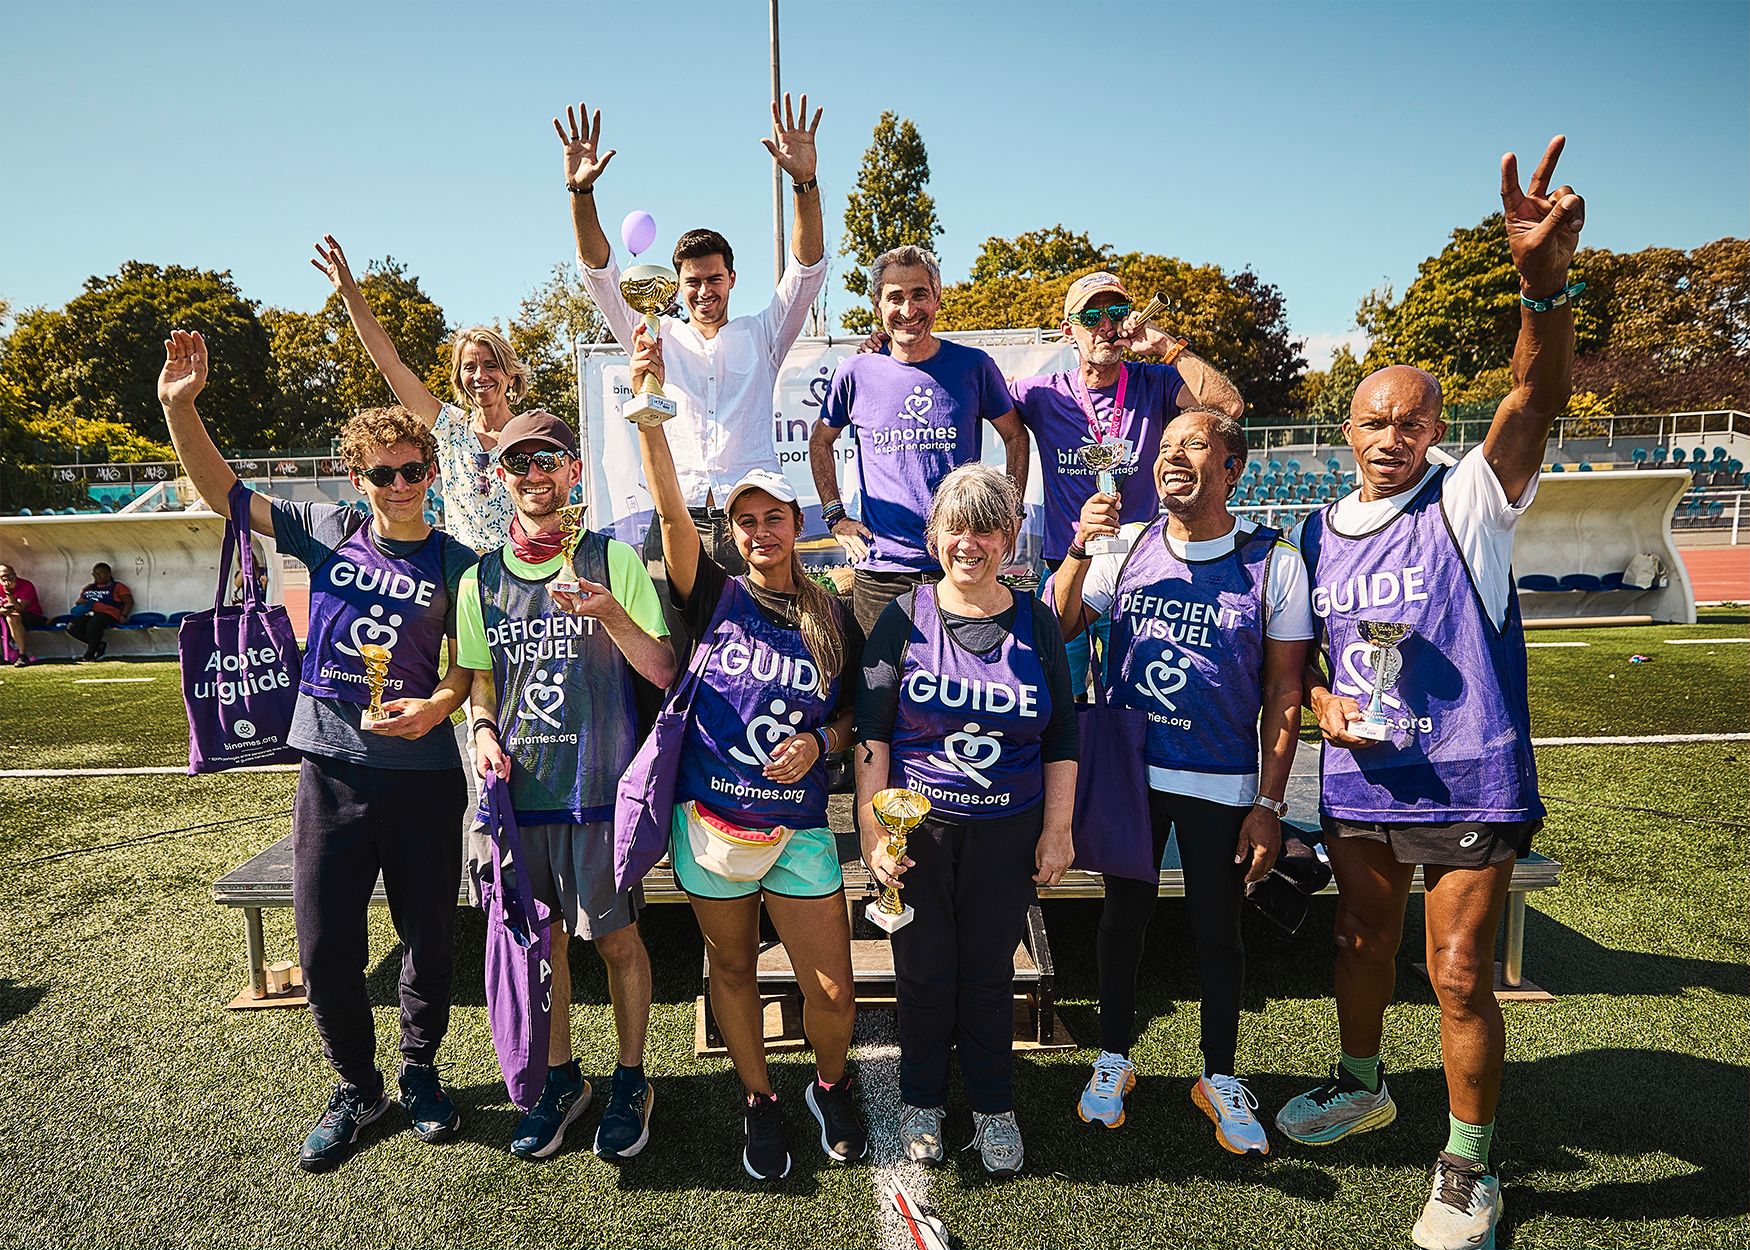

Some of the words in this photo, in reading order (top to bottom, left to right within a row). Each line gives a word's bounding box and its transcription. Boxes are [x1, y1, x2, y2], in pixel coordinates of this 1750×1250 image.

[871, 426, 957, 445] binomes
[919, 442, 957, 452] partage
[330, 561, 436, 608] GUIDE
[1311, 565, 1429, 618] GUIDE
[1120, 589, 1242, 631] DÉFICIENT
[486, 616, 597, 647] DÉFICIENT
[1130, 615, 1212, 648] VISUEL
[503, 638, 579, 665] VISUEL
[908, 669, 1038, 718] GUIDE
[223, 735, 278, 751] binomes.org
[710, 776, 806, 804] binomes.org
[908, 776, 1010, 805] binomes.org
